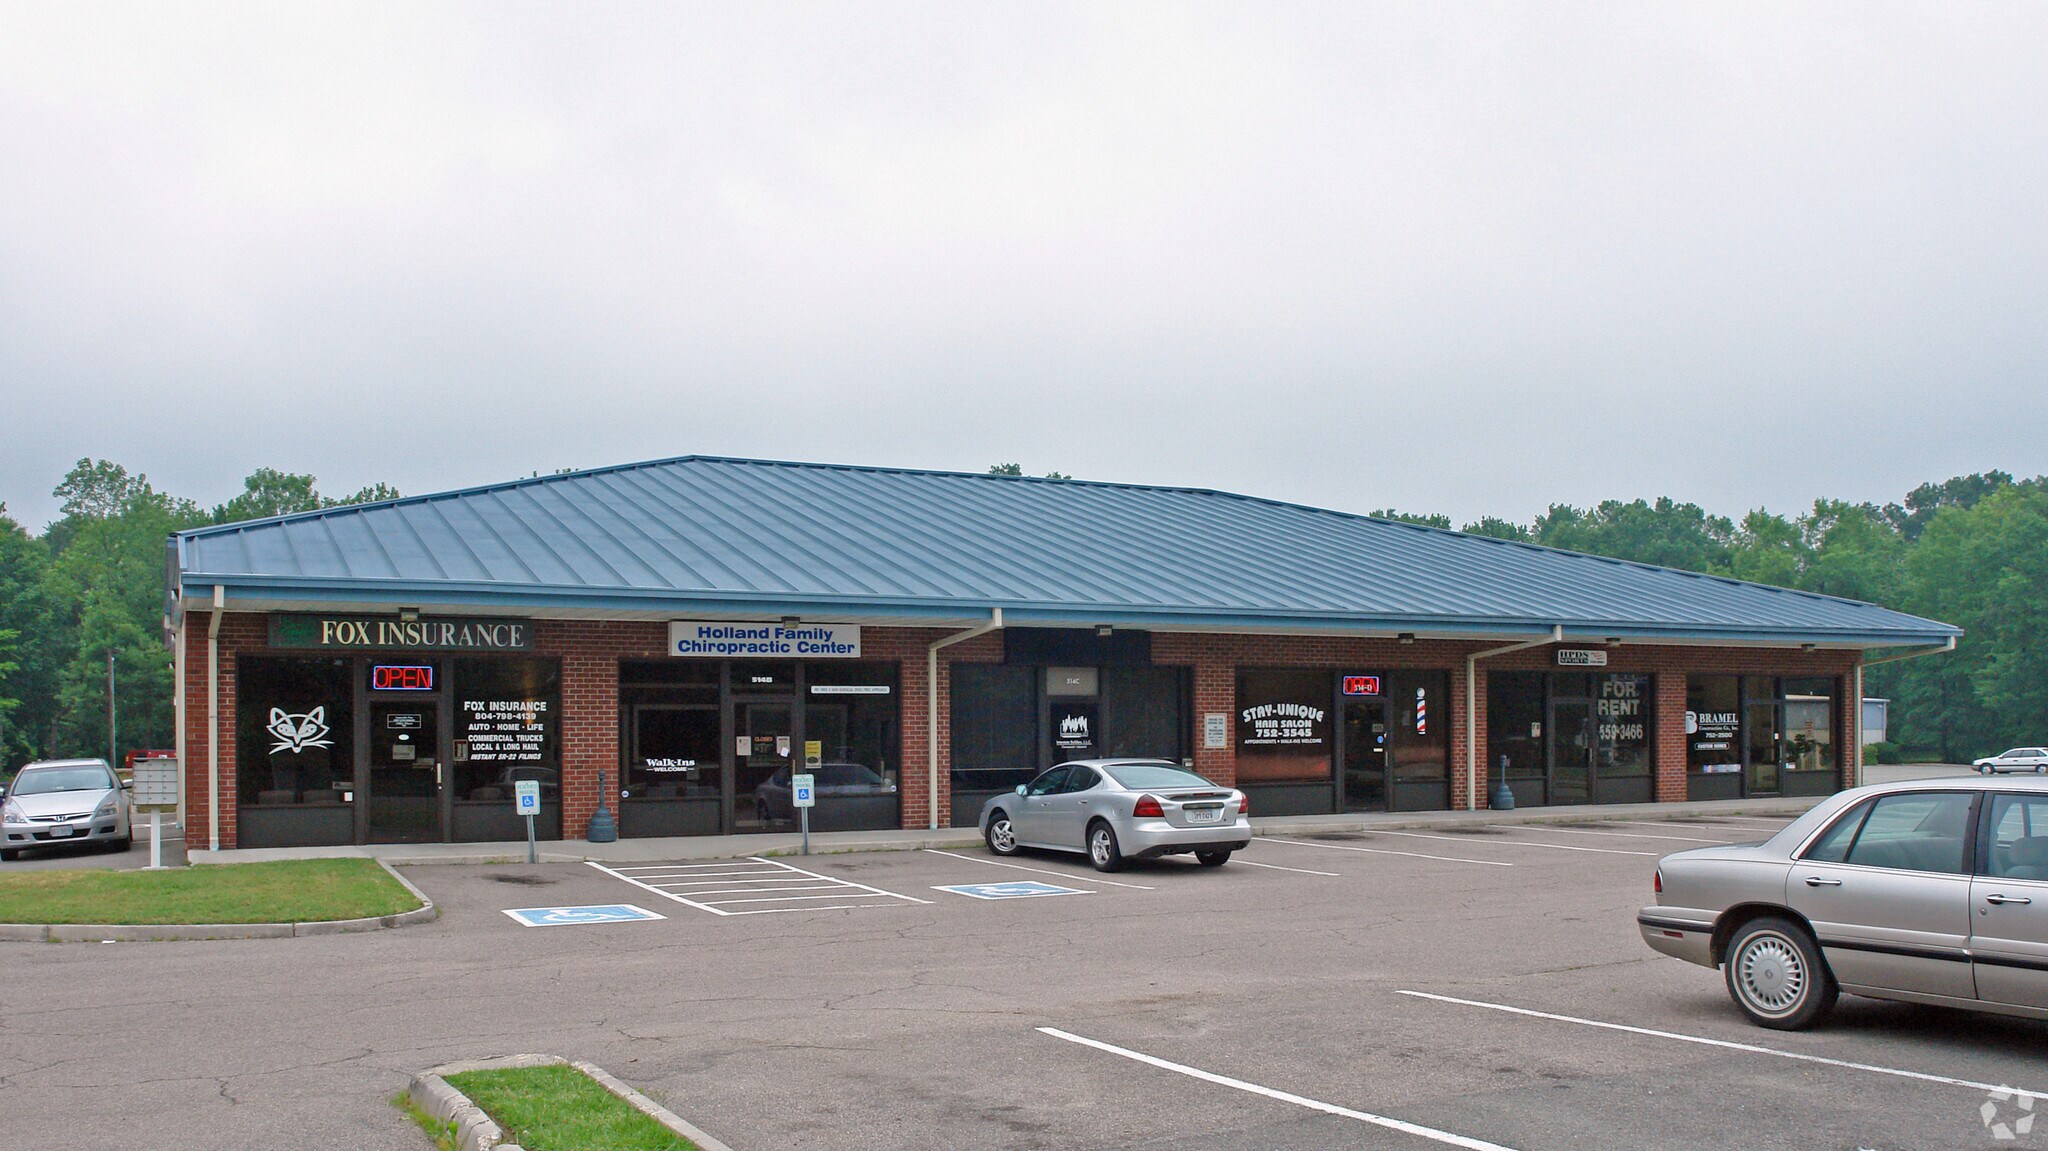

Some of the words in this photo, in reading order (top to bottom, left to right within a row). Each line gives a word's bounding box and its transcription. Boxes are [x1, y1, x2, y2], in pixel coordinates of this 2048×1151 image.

[322, 620, 371, 645] FOX
[378, 622, 524, 647] INSURANCE
[698, 626, 769, 640] Holland
[774, 627, 834, 642] Family
[677, 640, 791, 655] Chiropractic
[797, 641, 855, 654] Center
[374, 667, 431, 688] OPEN
[1602, 681, 1637, 697] FOR
[464, 701, 485, 711] FOX
[489, 702, 547, 711] INSURANCE
[1242, 703, 1324, 722] STAY-UNIQUE
[1598, 699, 1640, 715] RENT
[1255, 720, 1278, 728] HAIR
[1280, 720, 1312, 728] SALON
[1699, 713, 1739, 723] BRAMEL
[1255, 729, 1312, 737] 752-3545
[472, 743, 493, 751] LOCAL
[503, 743, 520, 751] LONG
[522, 743, 539, 751] HAUL
[646, 758, 695, 768] Walk-Ins
